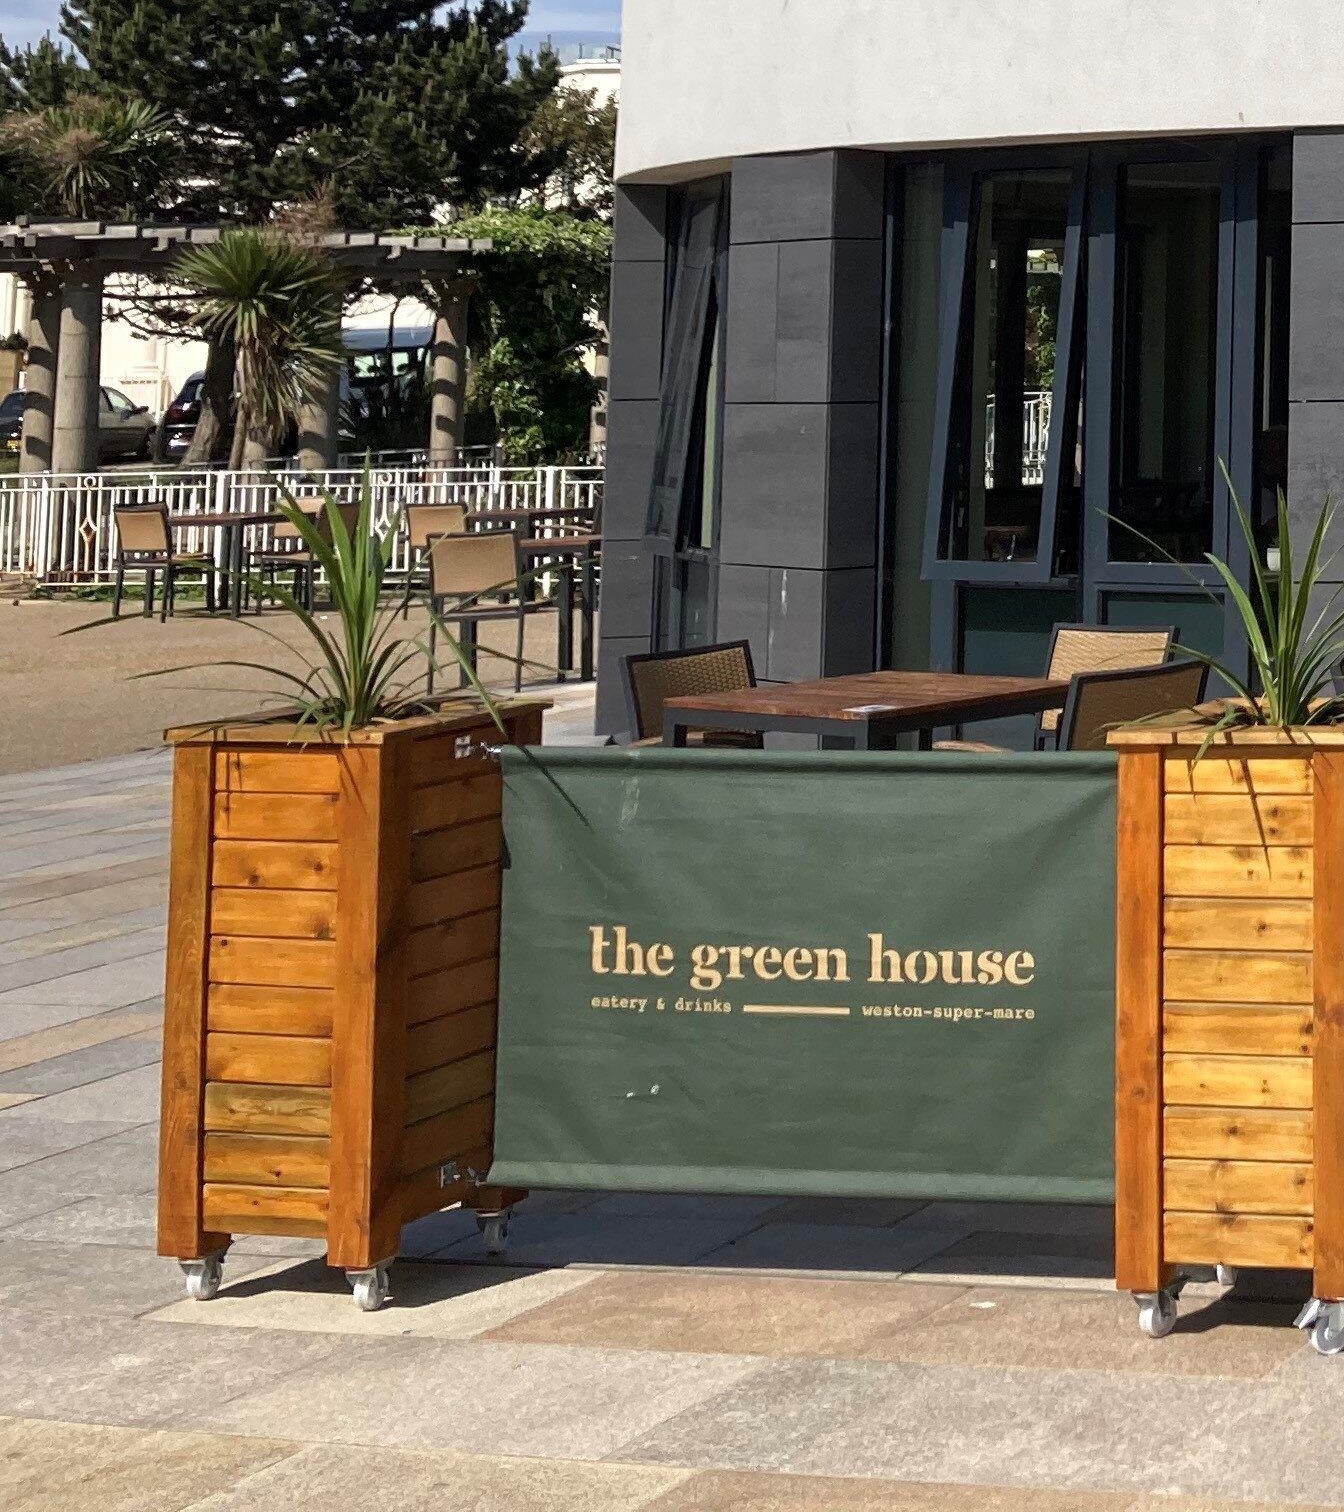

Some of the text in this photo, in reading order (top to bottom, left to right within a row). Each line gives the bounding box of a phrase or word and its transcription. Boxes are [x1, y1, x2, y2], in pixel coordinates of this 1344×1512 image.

[589, 925, 1036, 990] the green house
[591, 994, 732, 1014] eatery & drinks
[861, 1003, 1036, 1022] weston-super-mare
